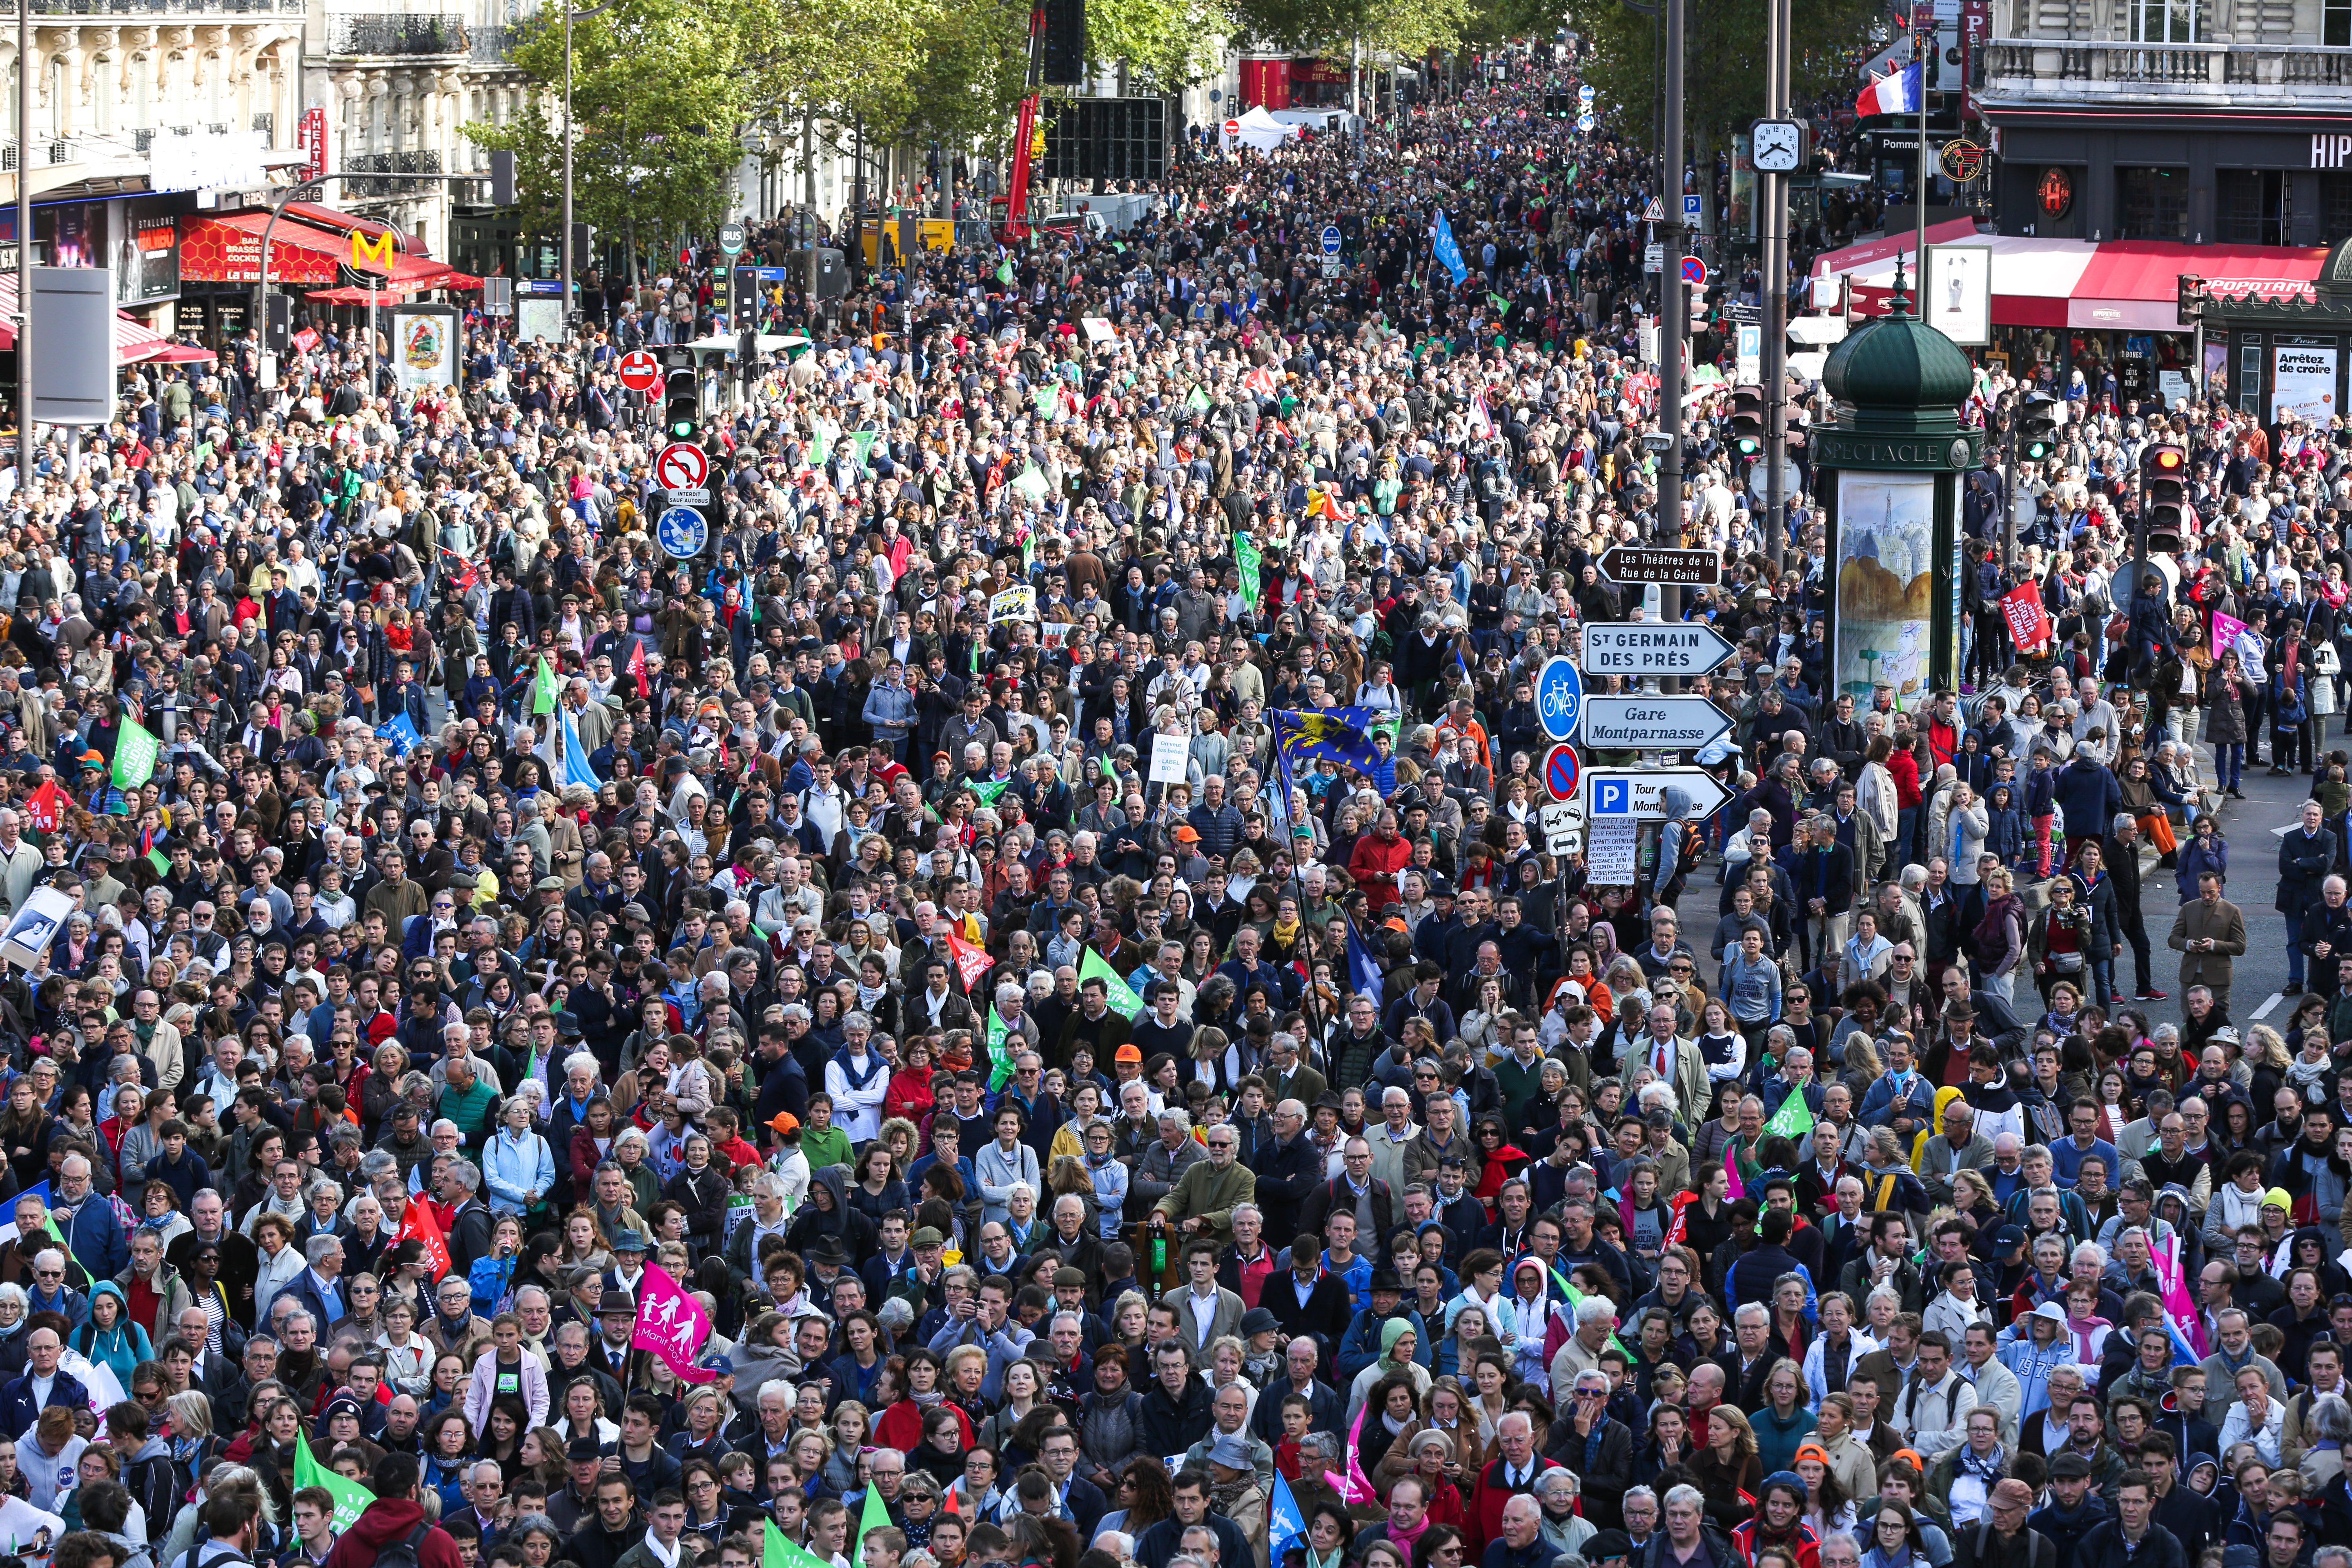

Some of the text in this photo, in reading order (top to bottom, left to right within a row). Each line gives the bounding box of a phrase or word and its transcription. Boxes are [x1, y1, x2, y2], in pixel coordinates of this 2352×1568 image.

[312, 110, 321, 179] THEATRE
[1883, 139, 1919, 149] Pomme
[1942, 142, 1961, 151] INDIANA
[2311, 134, 2352, 168] HIP
[2045, 183, 2061, 209] H
[1688, 199, 1696, 210] P
[139, 216, 174, 229] STALLONE
[138, 227, 175, 251] RAMBO
[723, 231, 741, 241] BUS
[352, 230, 393, 270] M
[1744, 333, 1755, 353] P
[2291, 336, 2319, 344] Presse
[2279, 354, 2324, 363] Arrêtez
[2279, 364, 2331, 374] de croire
[1824, 441, 1938, 462] SPECTACLE
[1620, 553, 1714, 566] Les Théâtres de la
[1620, 567, 1700, 580] Rue de la Gaité
[2002, 596, 2031, 645] PATERNITÉ
[1616, 633, 1699, 646] GERMAIN
[1600, 650, 1690, 666] DES PRÉS
[1625, 707, 1666, 720] Gare
[1591, 726, 1704, 742] Montparnasse
[1635, 784, 1656, 794] Tour
[1603, 785, 1619, 808] P
[736, 1208, 755, 1217] LIBERT
[640, 1328, 669, 1346] Manif
[2016, 1358, 2056, 1377] 1976
